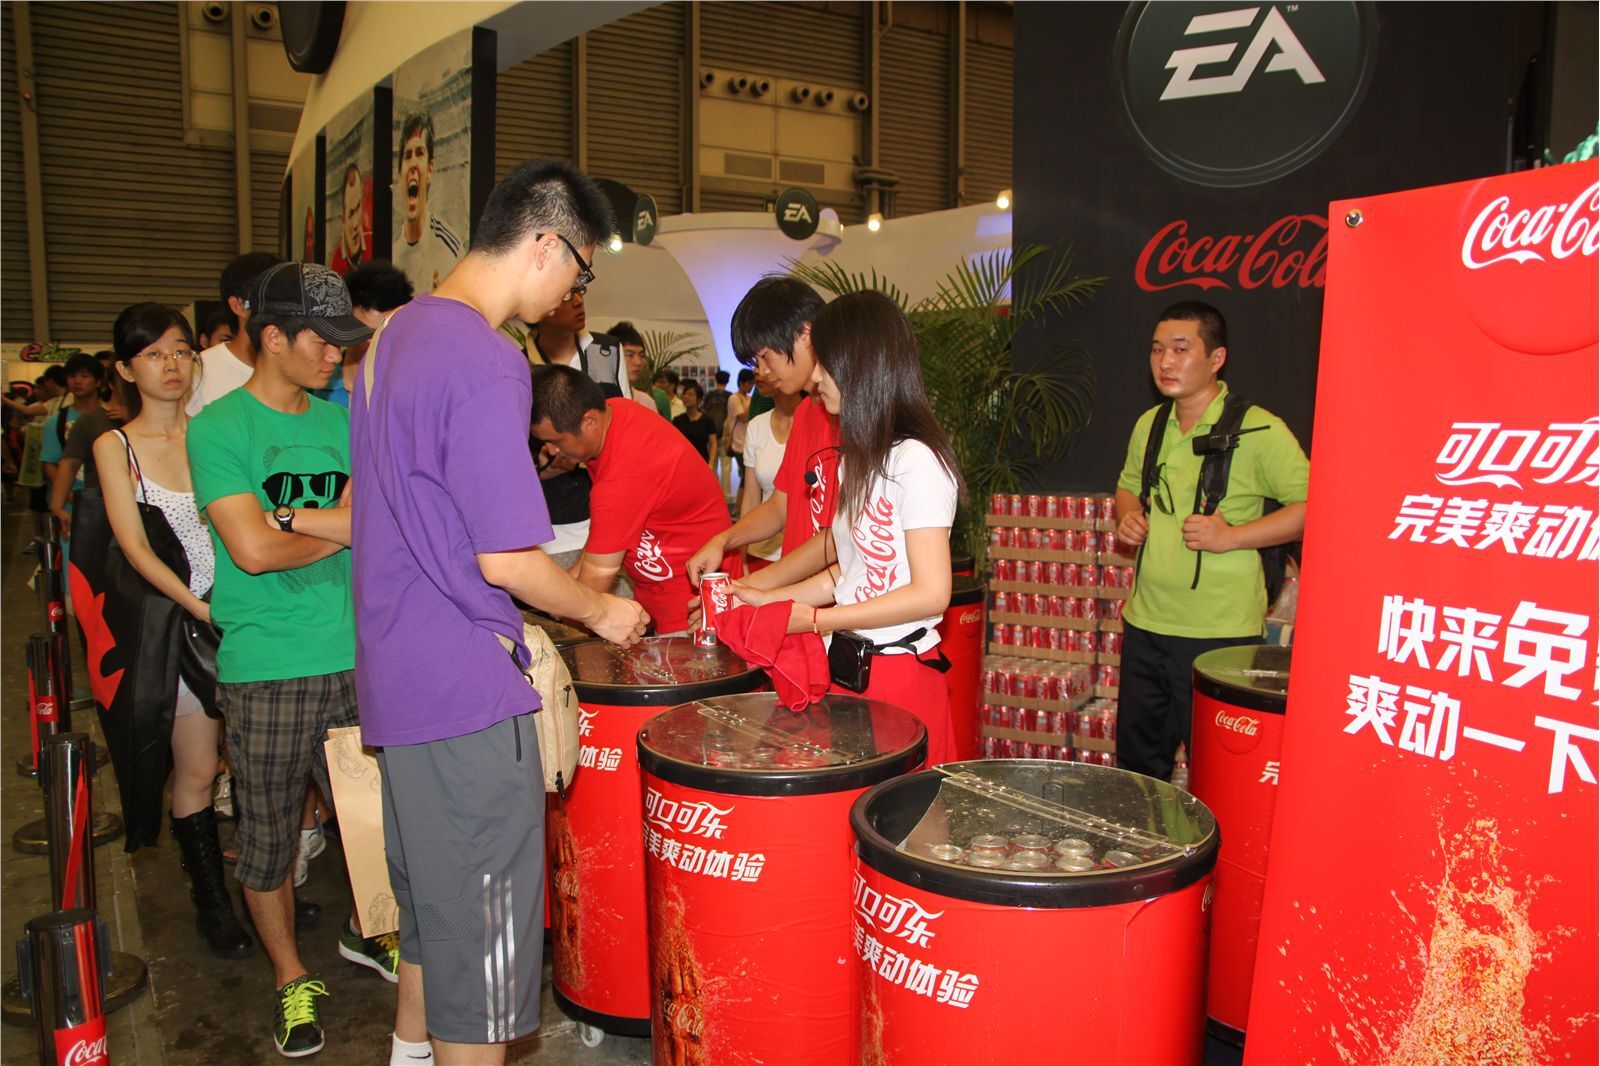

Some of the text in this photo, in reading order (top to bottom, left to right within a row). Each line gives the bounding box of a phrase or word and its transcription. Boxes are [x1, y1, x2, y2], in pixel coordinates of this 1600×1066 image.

[1159, 5, 1326, 101] EA
[637, 210, 653, 231] EA
[784, 203, 812, 224] EA
[1377, 594, 1599, 706] 快来免
[1215, 710, 1260, 737] Coca-Cola
[645, 786, 735, 839] 可口可乐
